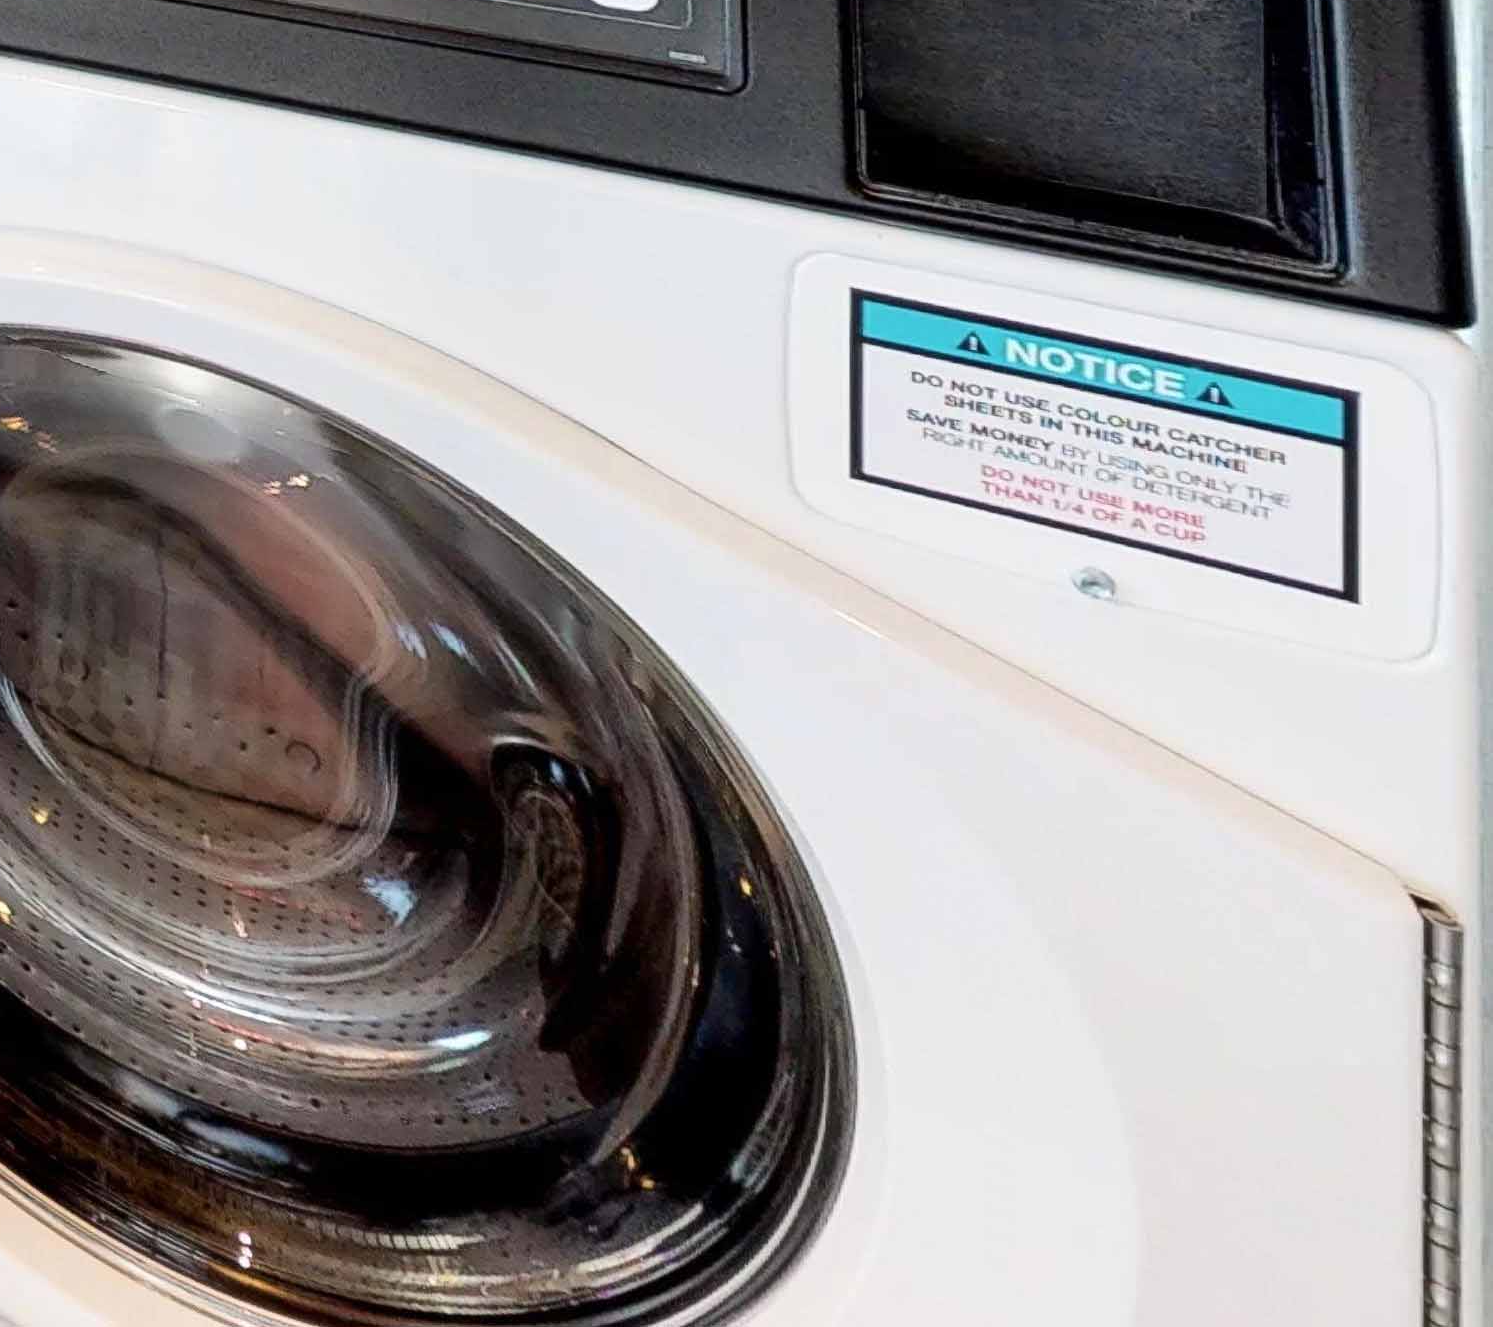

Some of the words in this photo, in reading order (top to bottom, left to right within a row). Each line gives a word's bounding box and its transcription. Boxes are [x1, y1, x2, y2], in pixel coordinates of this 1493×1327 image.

[1004, 338, 1186, 398] NOTICE
[906, 408, 962, 433] SAVE
[970, 422, 1055, 453] MONEY
[1061, 443, 1091, 461] BY
[1096, 447, 1170, 481] USING
[1175, 469, 1237, 494] ONLY
[1247, 484, 1293, 508] THE
[910, 370, 944, 389] DO
[950, 379, 999, 400] NOT
[1004, 391, 1051, 412] USE
[1057, 401, 1160, 437] COLOUR
[1167, 426, 1287, 466] CATCHER
[944, 393, 1033, 426] SHEETS
[1039, 413, 1064, 432] IN
[1071, 421, 1125, 446] THIS
[1132, 436, 1249, 475] MACHINE
[922, 426, 985, 453] RIGHT
[993, 444, 1089, 478] AMOUNT
[1094, 466, 1125, 484] OF
[1132, 475, 1272, 521] DETERGENT
[980, 463, 1015, 482] DO
[1021, 473, 1074, 496] NOT
[1078, 488, 1124, 509] USE
[1132, 498, 1207, 530] MORE
[980, 480, 1044, 507] THAN
[1053, 496, 1086, 516] 1/4
[1091, 506, 1125, 523] OF
[1131, 516, 1147, 531] A
[1153, 521, 1207, 544] CUP
